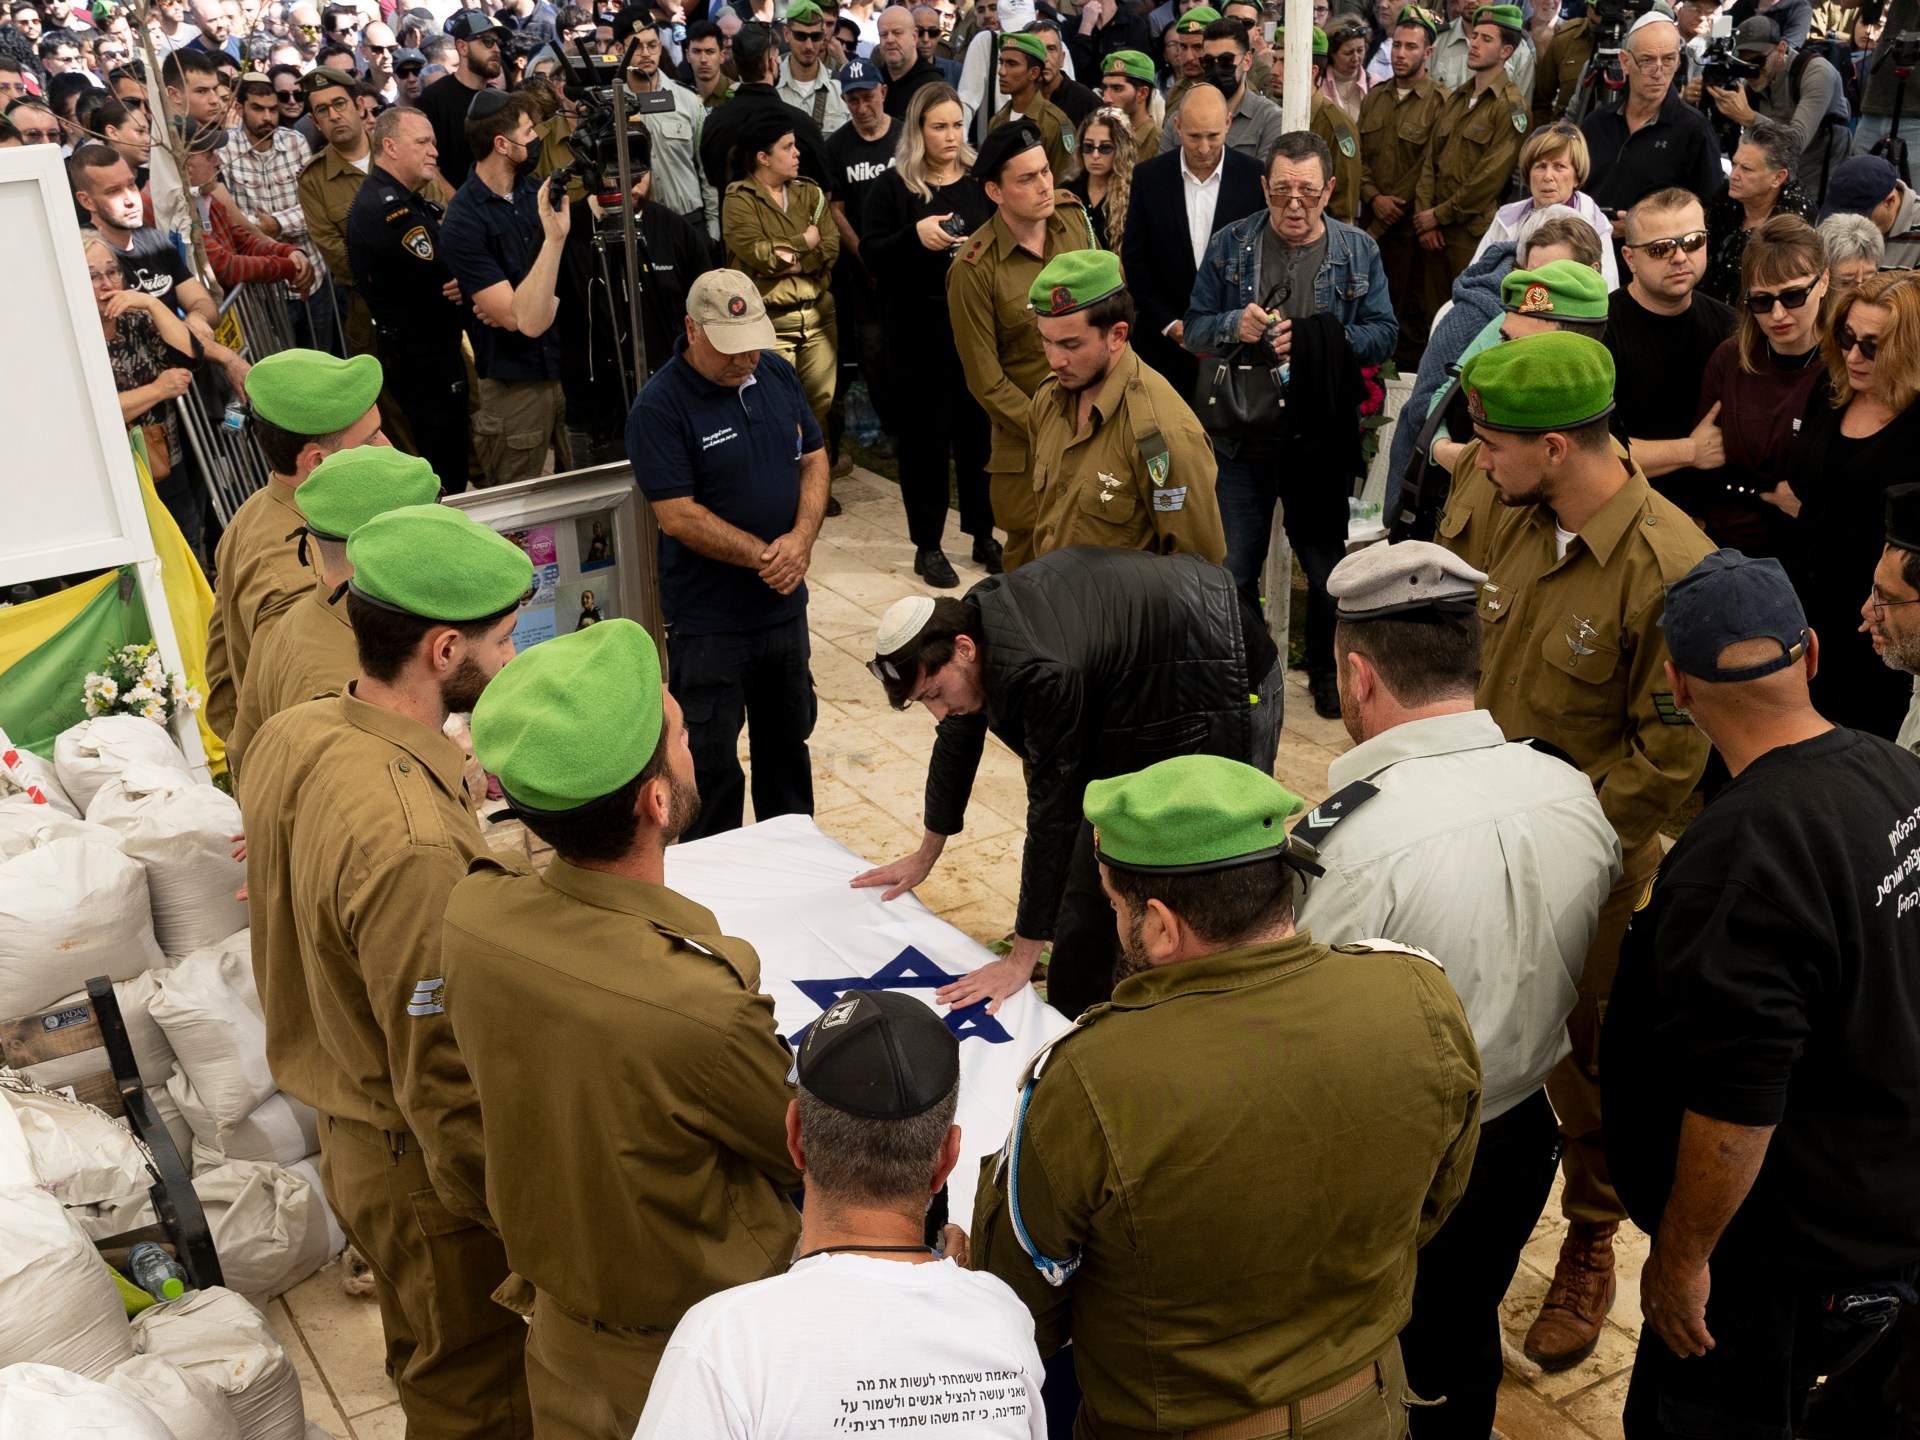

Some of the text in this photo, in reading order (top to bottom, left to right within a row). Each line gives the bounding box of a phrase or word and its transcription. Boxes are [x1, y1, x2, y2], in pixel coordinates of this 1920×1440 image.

[846, 161, 886, 183] Nike
[856, 1379, 876, 1391] מה
[878, 1378, 897, 1390] את
[899, 1372, 936, 1388] לעשות
[938, 1372, 982, 1386] ששמחתי
[840, 1386, 1026, 1414] שאני עושה להציל אנשים ולשמור על
[930, 1412, 959, 1425] משהו
[962, 1410, 976, 1422] זה
[978, 1408, 989, 1420] כי
[888, 1414, 927, 1429] שתמיד
